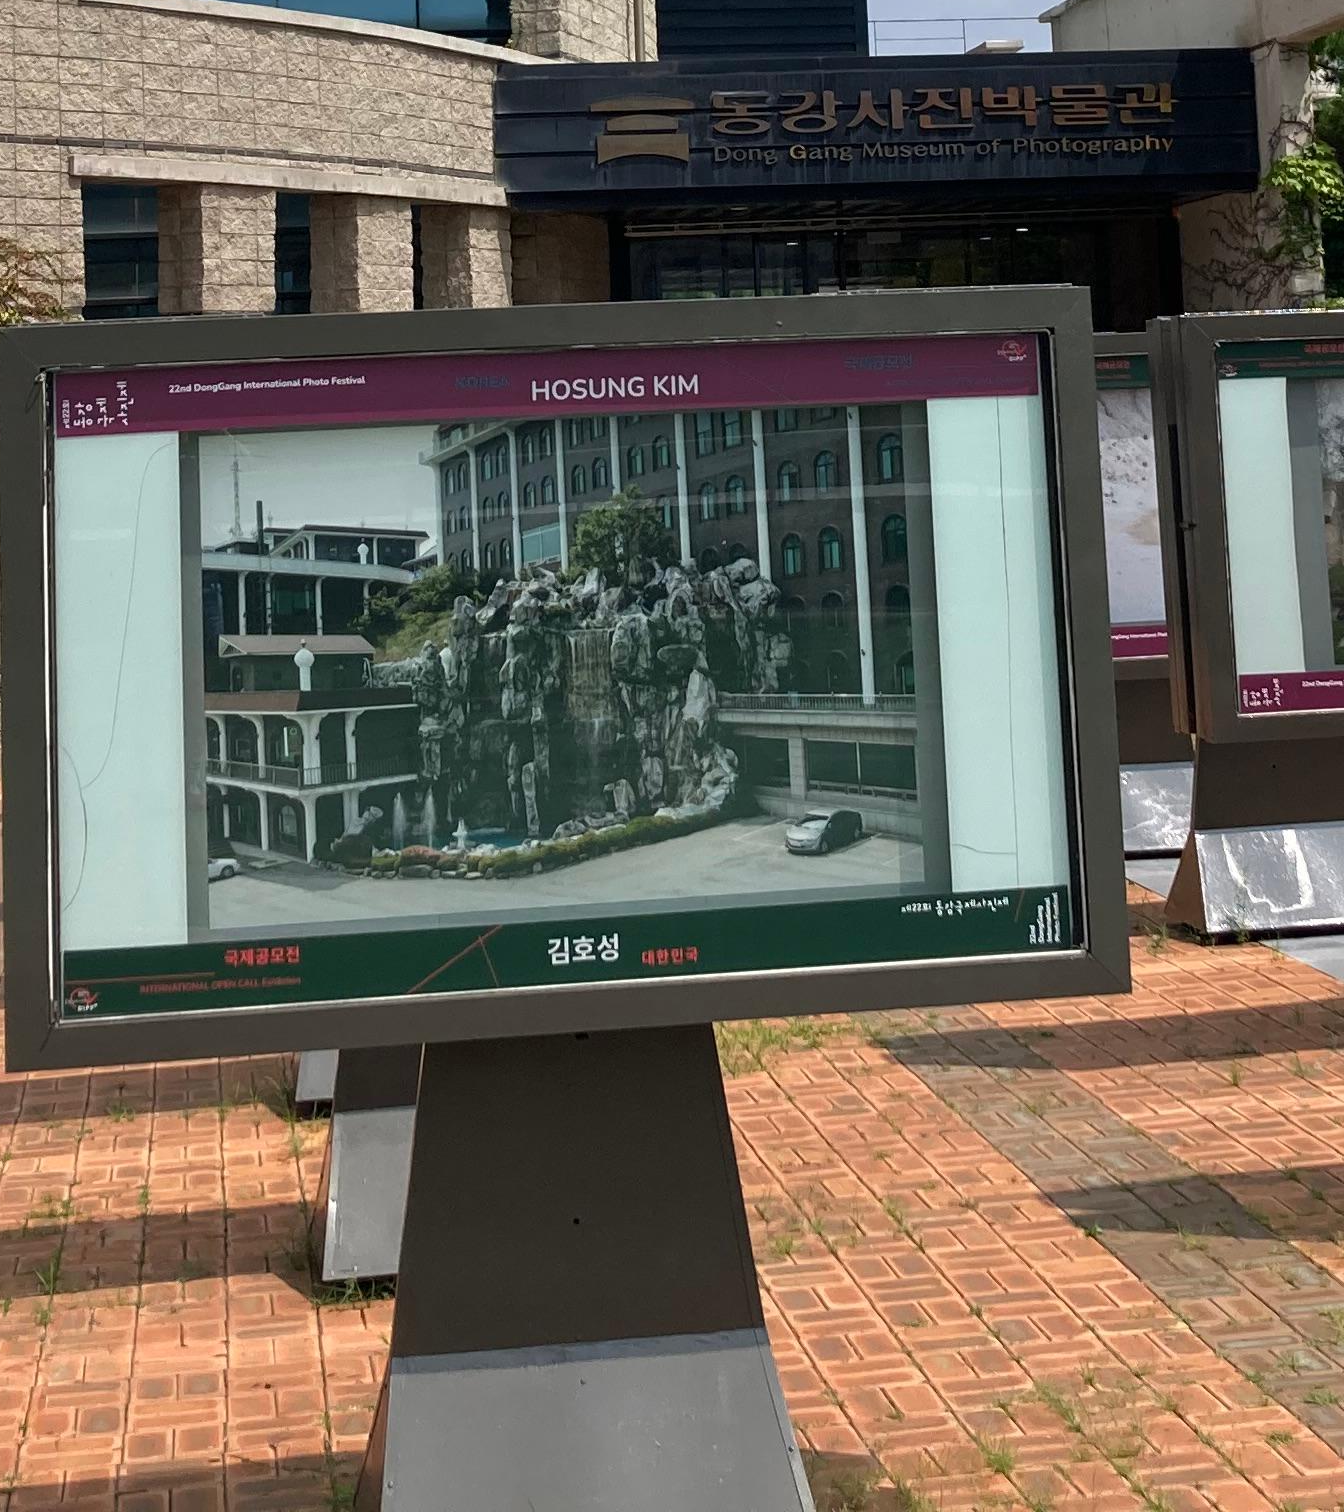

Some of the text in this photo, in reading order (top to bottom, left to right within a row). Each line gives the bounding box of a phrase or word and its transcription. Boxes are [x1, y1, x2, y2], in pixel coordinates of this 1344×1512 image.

[710, 82, 1180, 136] 동강사진박물관
[713, 135, 1175, 165] Dong Gang Museum of Photography
[168, 374, 366, 394] 22nd DongGang International Photo Festival
[530, 375, 645, 402] HOSUNG
[653, 373, 699, 397] KIM
[223, 943, 301, 968] 국제공모전
[546, 932, 699, 968] 김호성 대한민국
